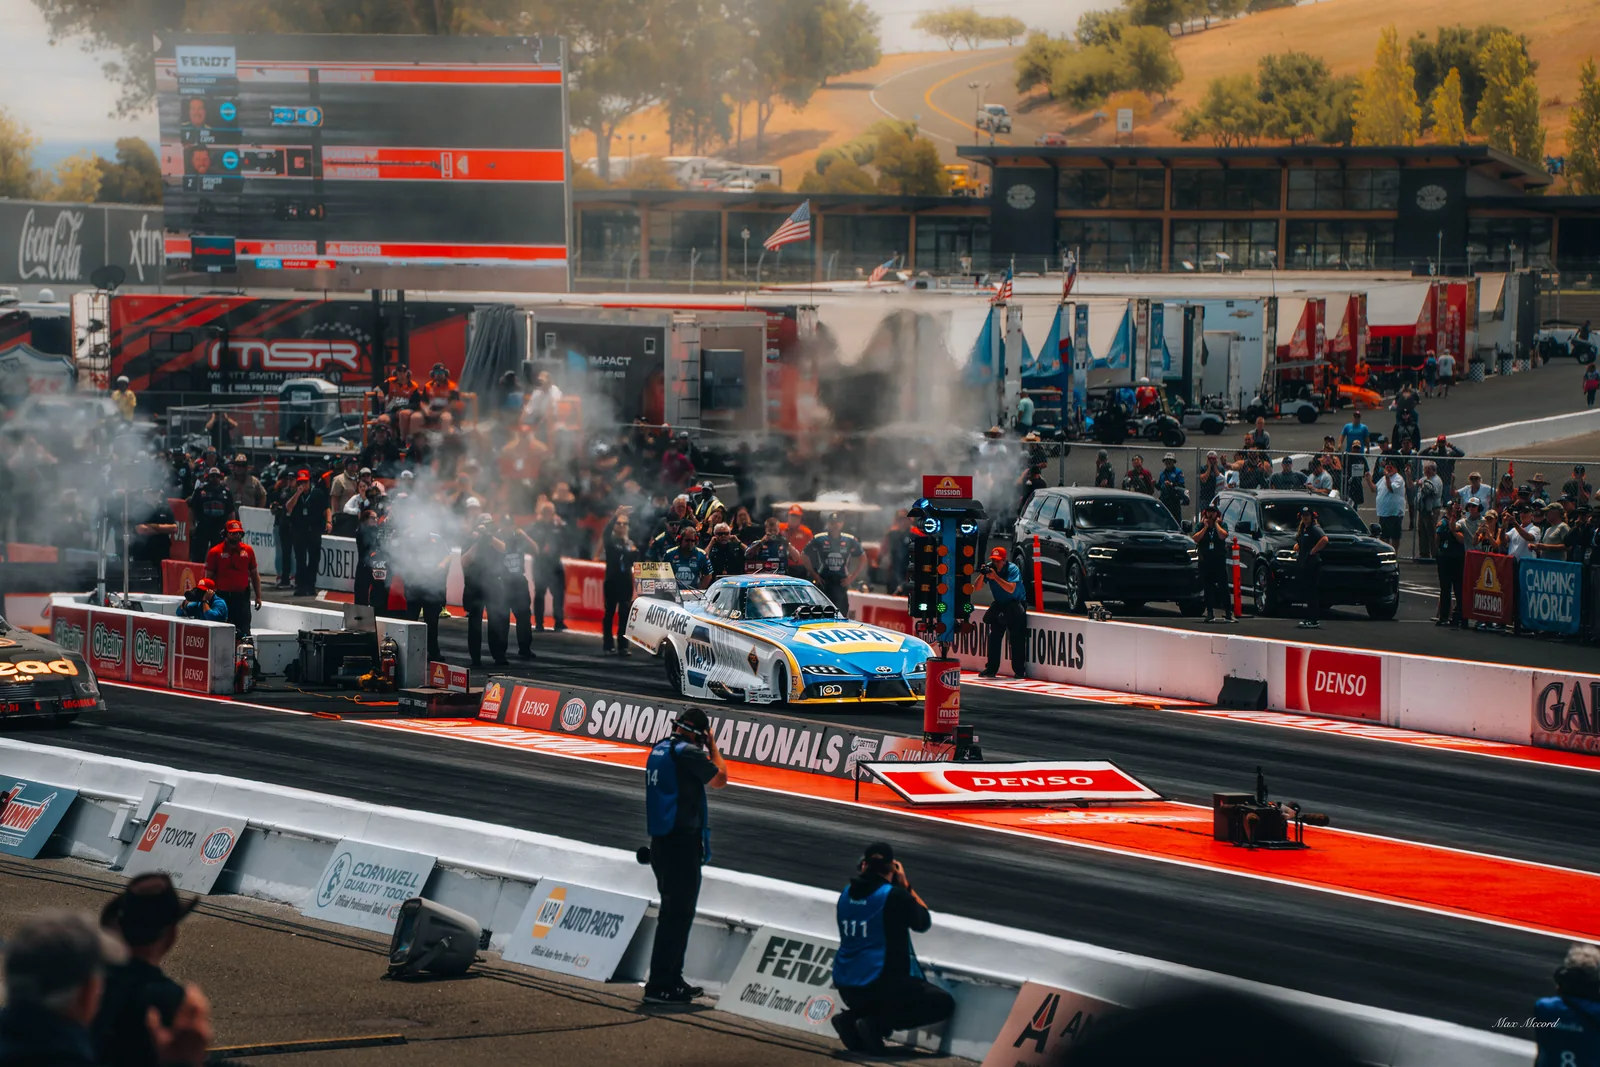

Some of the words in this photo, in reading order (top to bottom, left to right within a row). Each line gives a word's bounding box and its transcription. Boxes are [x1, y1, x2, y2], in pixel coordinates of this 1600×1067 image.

[180, 55, 232, 68] FENDT
[274, 243, 315, 253] MISSION
[340, 245, 381, 255] MISSION
[210, 341, 358, 369] MSR
[249, 371, 283, 380] SMITH
[641, 562, 669, 571] CARLYLE
[1526, 568, 1576, 596] CAMPING
[1474, 593, 1502, 613] MISSION
[1526, 591, 1574, 623] WORLD
[644, 604, 667, 627] AUTO
[666, 609, 690, 635] CARE
[93, 622, 124, 665] O'Reilly
[185, 635, 205, 649] DENSO
[806, 629, 894, 646] NAPA
[134, 628, 167, 672] O'Reilly
[184, 668, 204, 682] DENSO
[452, 675, 465, 684] DENSO
[1313, 669, 1367, 697] DENSO
[521, 700, 550, 717] DENSO
[562, 704, 583, 727] NHRA
[587, 699, 678, 745] SONOM
[646, 769, 659, 786] 14
[972, 775, 1094, 787] DENSO
[161, 827, 197, 849] TOYOTA
[205, 832, 231, 858] NHRA
[352, 862, 419, 888] CORNWELL
[344, 879, 382, 895] QUALITY
[382, 886, 414, 901] TOOLS
[335, 894, 351, 909] Official
[350, 897, 375, 913] Professional
[538, 901, 561, 925] NAPA
[558, 904, 593, 933] AUTO
[585, 911, 624, 939] PARTS
[842, 920, 867, 938] 111
[531, 945, 547, 956] Official
[756, 935, 838, 990] FEND
[740, 983, 772, 1007] Official
[768, 989, 799, 1013] Tractor
[798, 995, 812, 1016] of
[1561, 1051, 1578, 1067] 8
